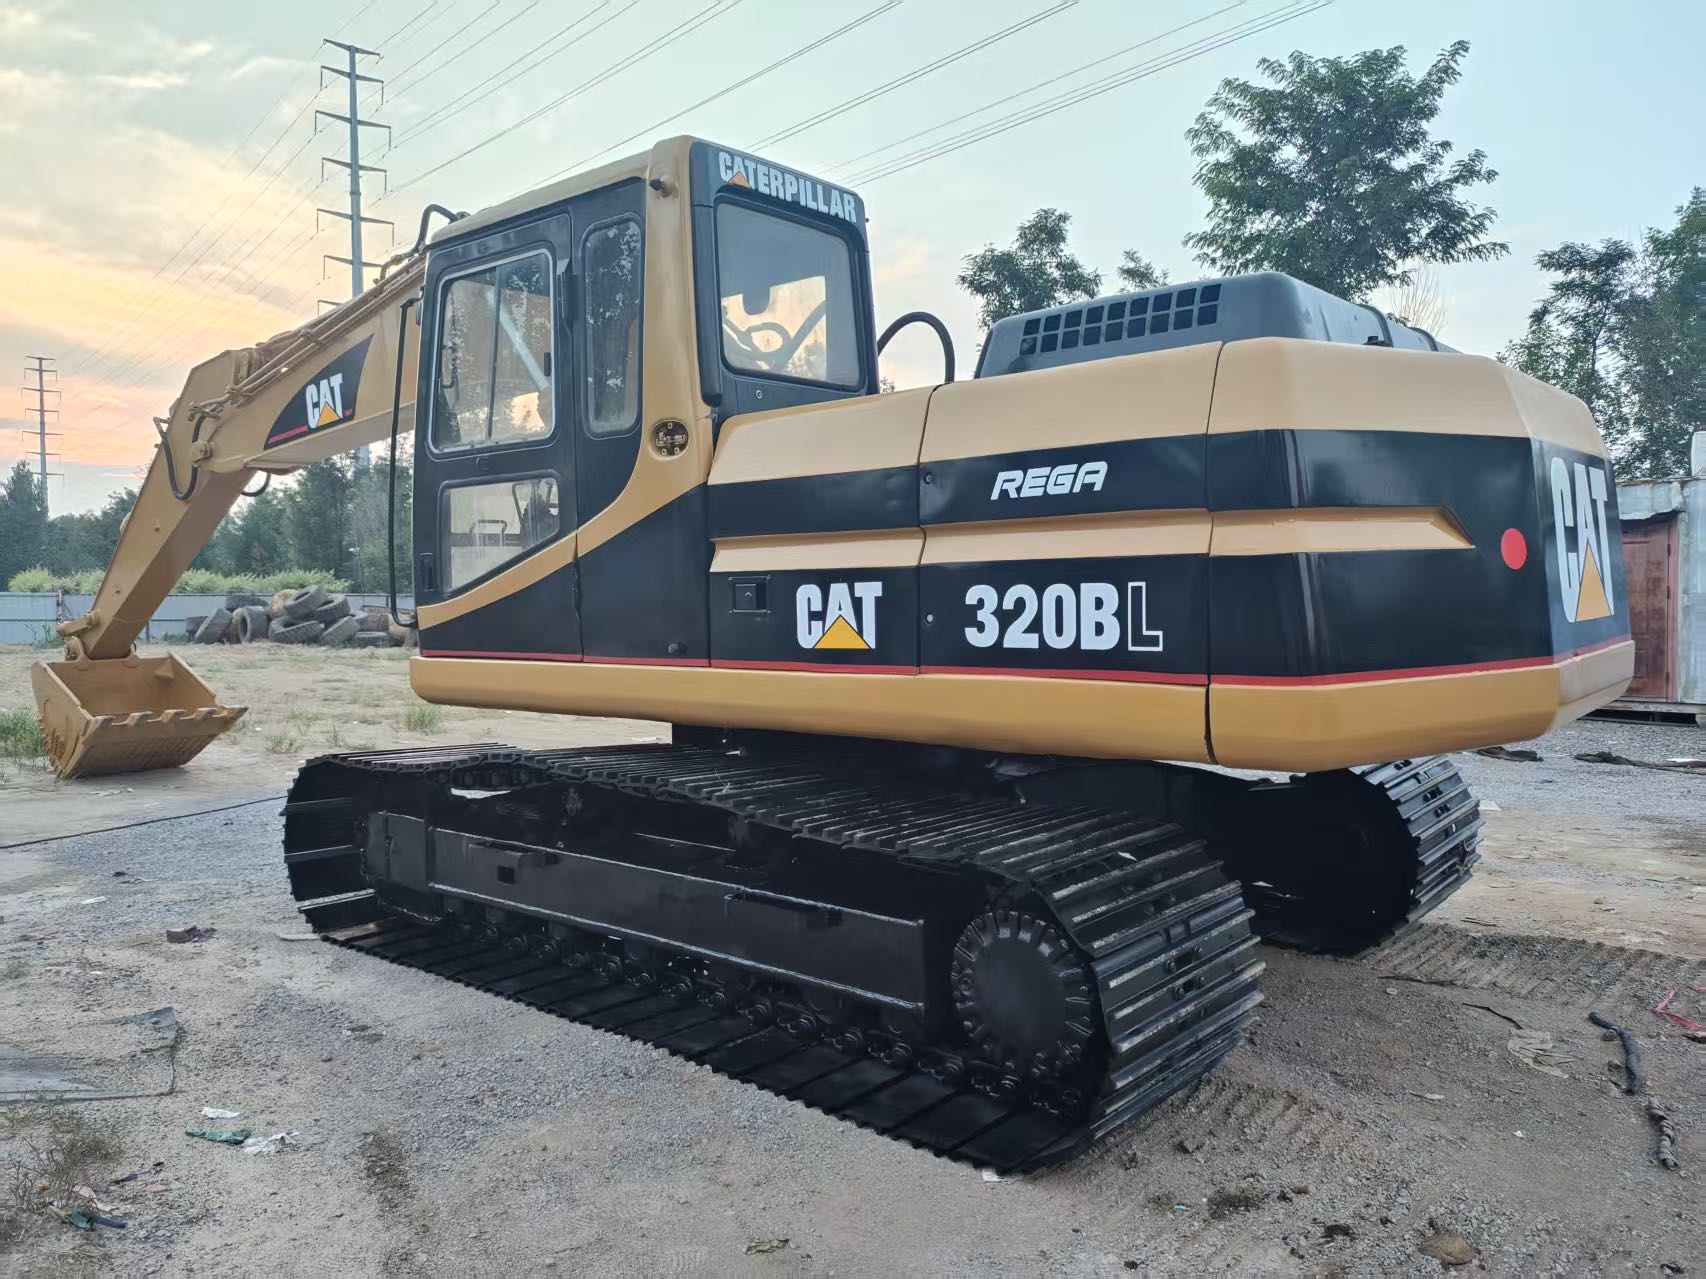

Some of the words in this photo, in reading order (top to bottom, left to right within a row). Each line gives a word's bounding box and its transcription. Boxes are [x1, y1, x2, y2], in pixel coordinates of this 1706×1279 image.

[718, 151, 857, 223] CATERPILLAR
[305, 373, 344, 429] CAT
[990, 460, 1108, 500] REGA
[1551, 456, 1614, 622] CAT
[796, 581, 883, 649] CAT
